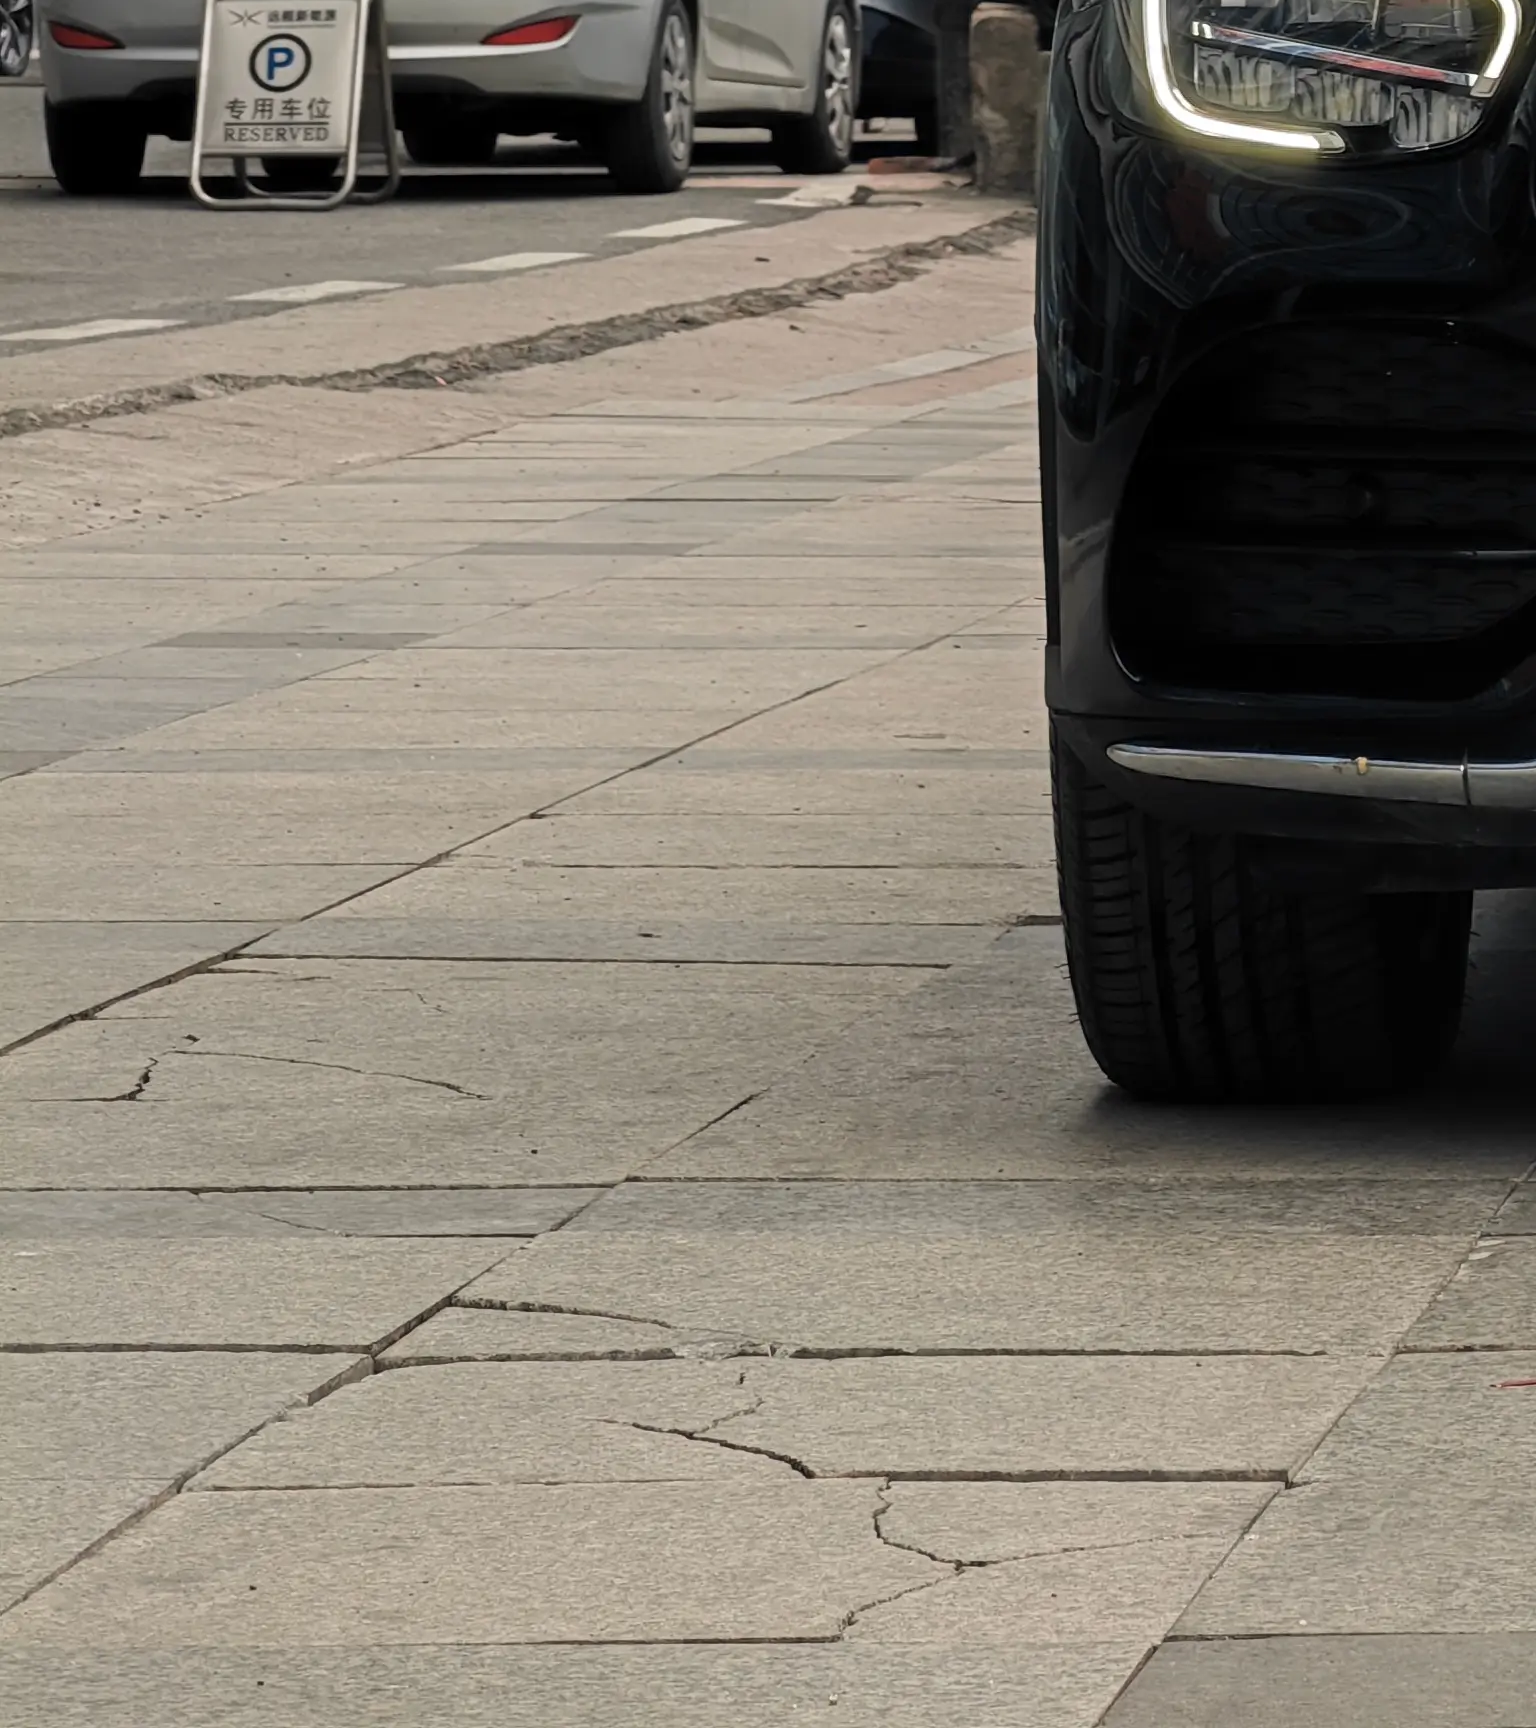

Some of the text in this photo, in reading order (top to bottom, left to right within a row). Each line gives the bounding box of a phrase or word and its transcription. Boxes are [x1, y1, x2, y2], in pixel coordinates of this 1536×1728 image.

[265, 46, 295, 81] P
[224, 97, 332, 121] 专用车位
[223, 126, 330, 143] RESERVED
